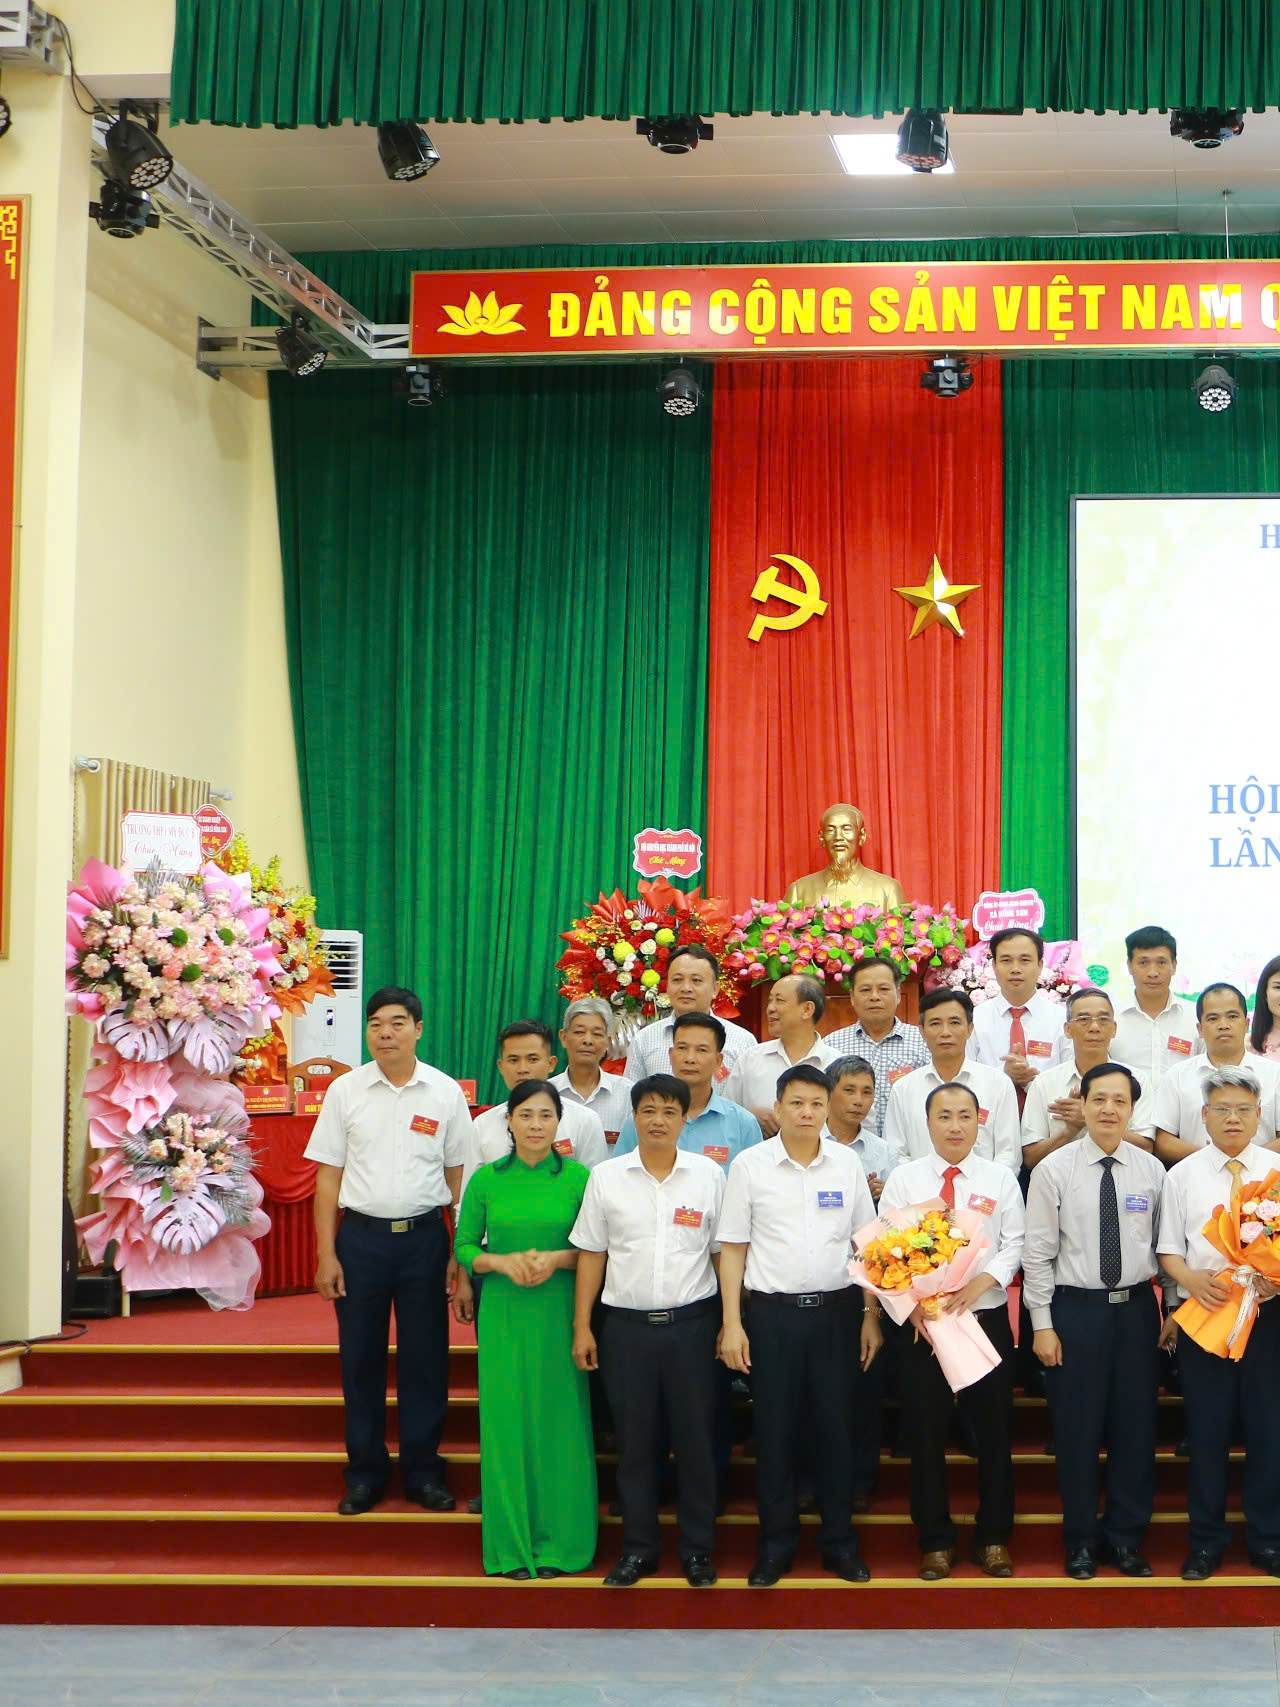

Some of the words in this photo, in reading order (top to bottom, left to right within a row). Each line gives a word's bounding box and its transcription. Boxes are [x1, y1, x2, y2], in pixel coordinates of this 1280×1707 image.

[548, 273, 692, 338] ĐẢNG
[707, 277, 853, 345] CỘNG
[869, 270, 978, 333] SẢN
[993, 275, 1106, 341] VIỆT
[1121, 284, 1243, 330] NAM
[1209, 776, 1280, 822] HỘI
